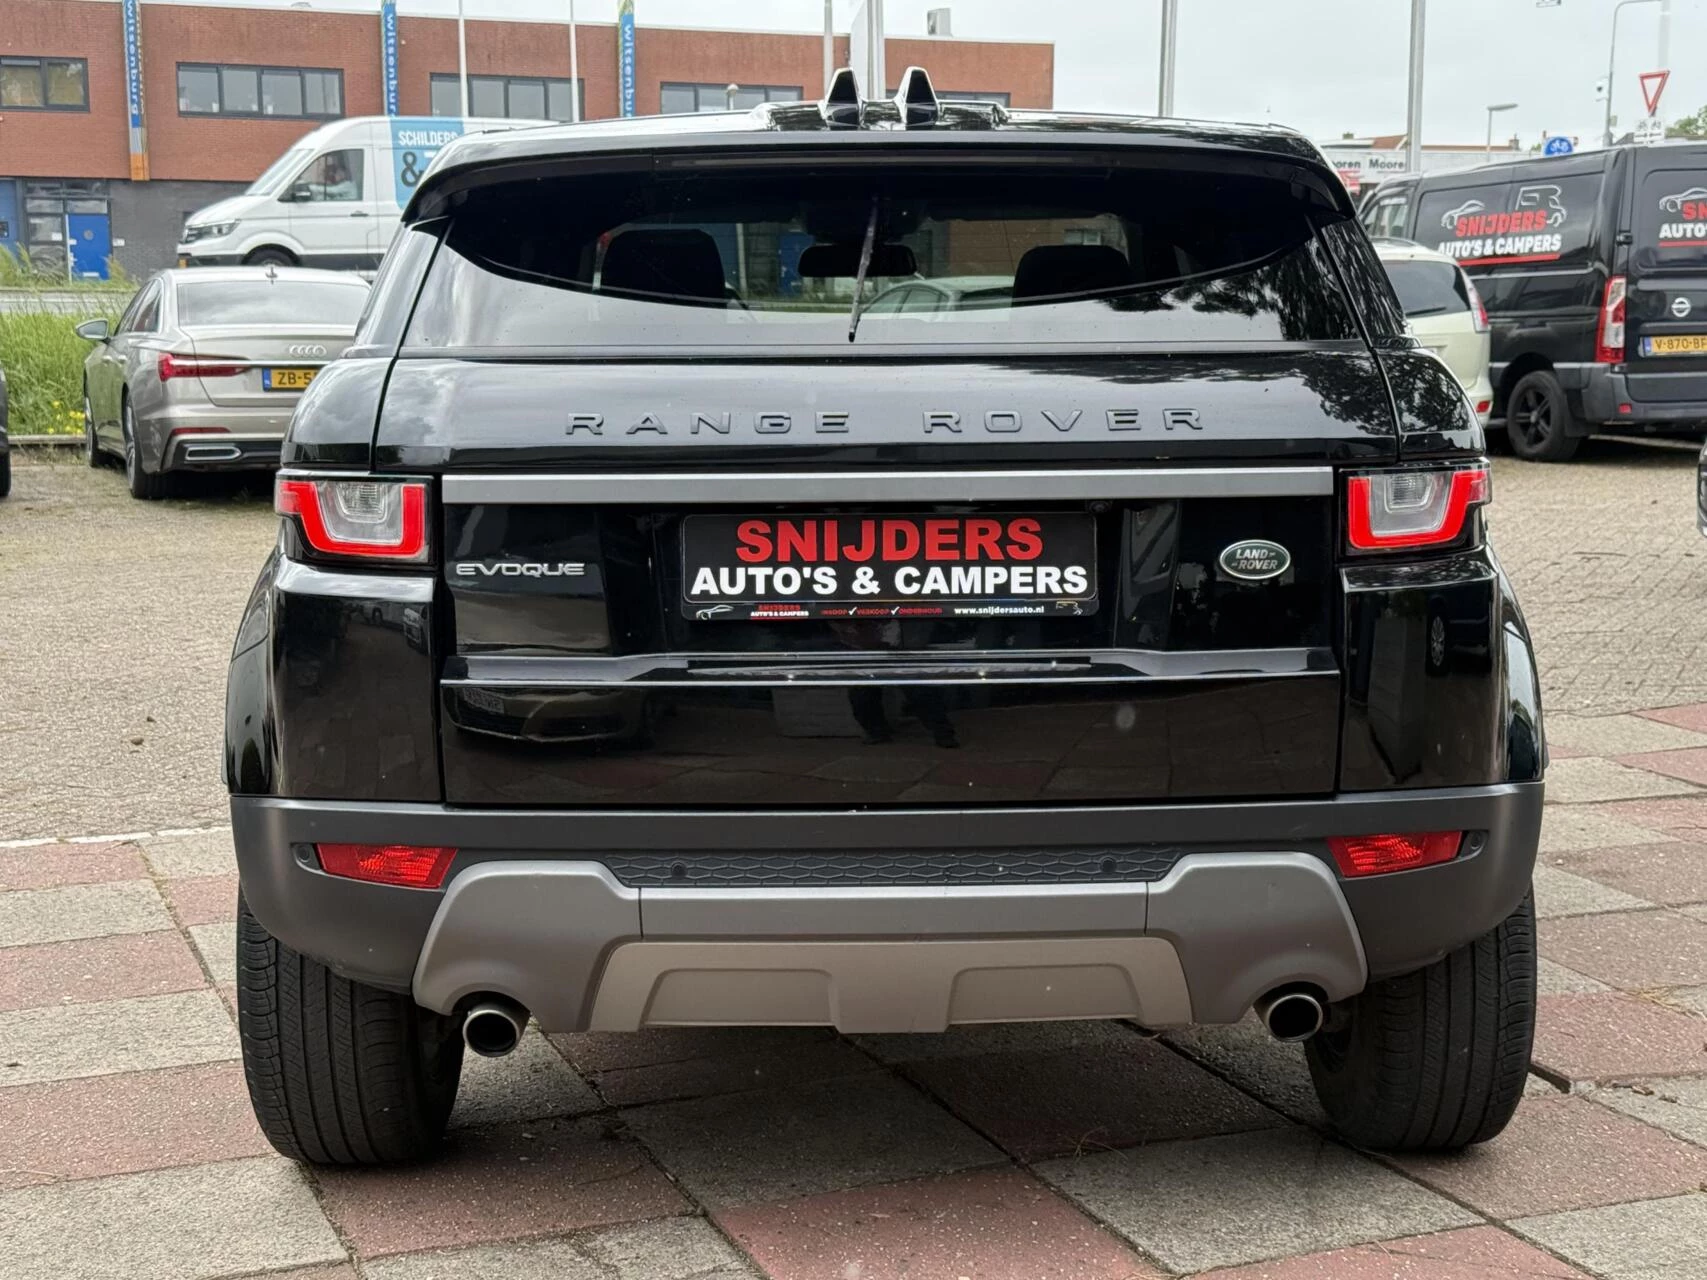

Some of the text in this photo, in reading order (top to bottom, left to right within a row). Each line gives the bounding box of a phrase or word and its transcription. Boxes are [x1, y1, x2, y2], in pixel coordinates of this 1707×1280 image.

[1455, 209, 1547, 237] SNIJDERS
[1438, 233, 1562, 257] AUTO'S & CAMPERS
[278, 372, 317, 385] ZB-5
[565, 408, 1203, 435] RANGE ROVER
[736, 518, 1044, 563] SNIJDERS
[1236, 549, 1269, 559] LAND
[456, 563, 585, 578] EVOQUE
[1238, 560, 1278, 570] ROVER
[690, 566, 1089, 596] AUTO'S & CAMPERS
[954, 606, 1045, 615] www.snijdersauto.nl
